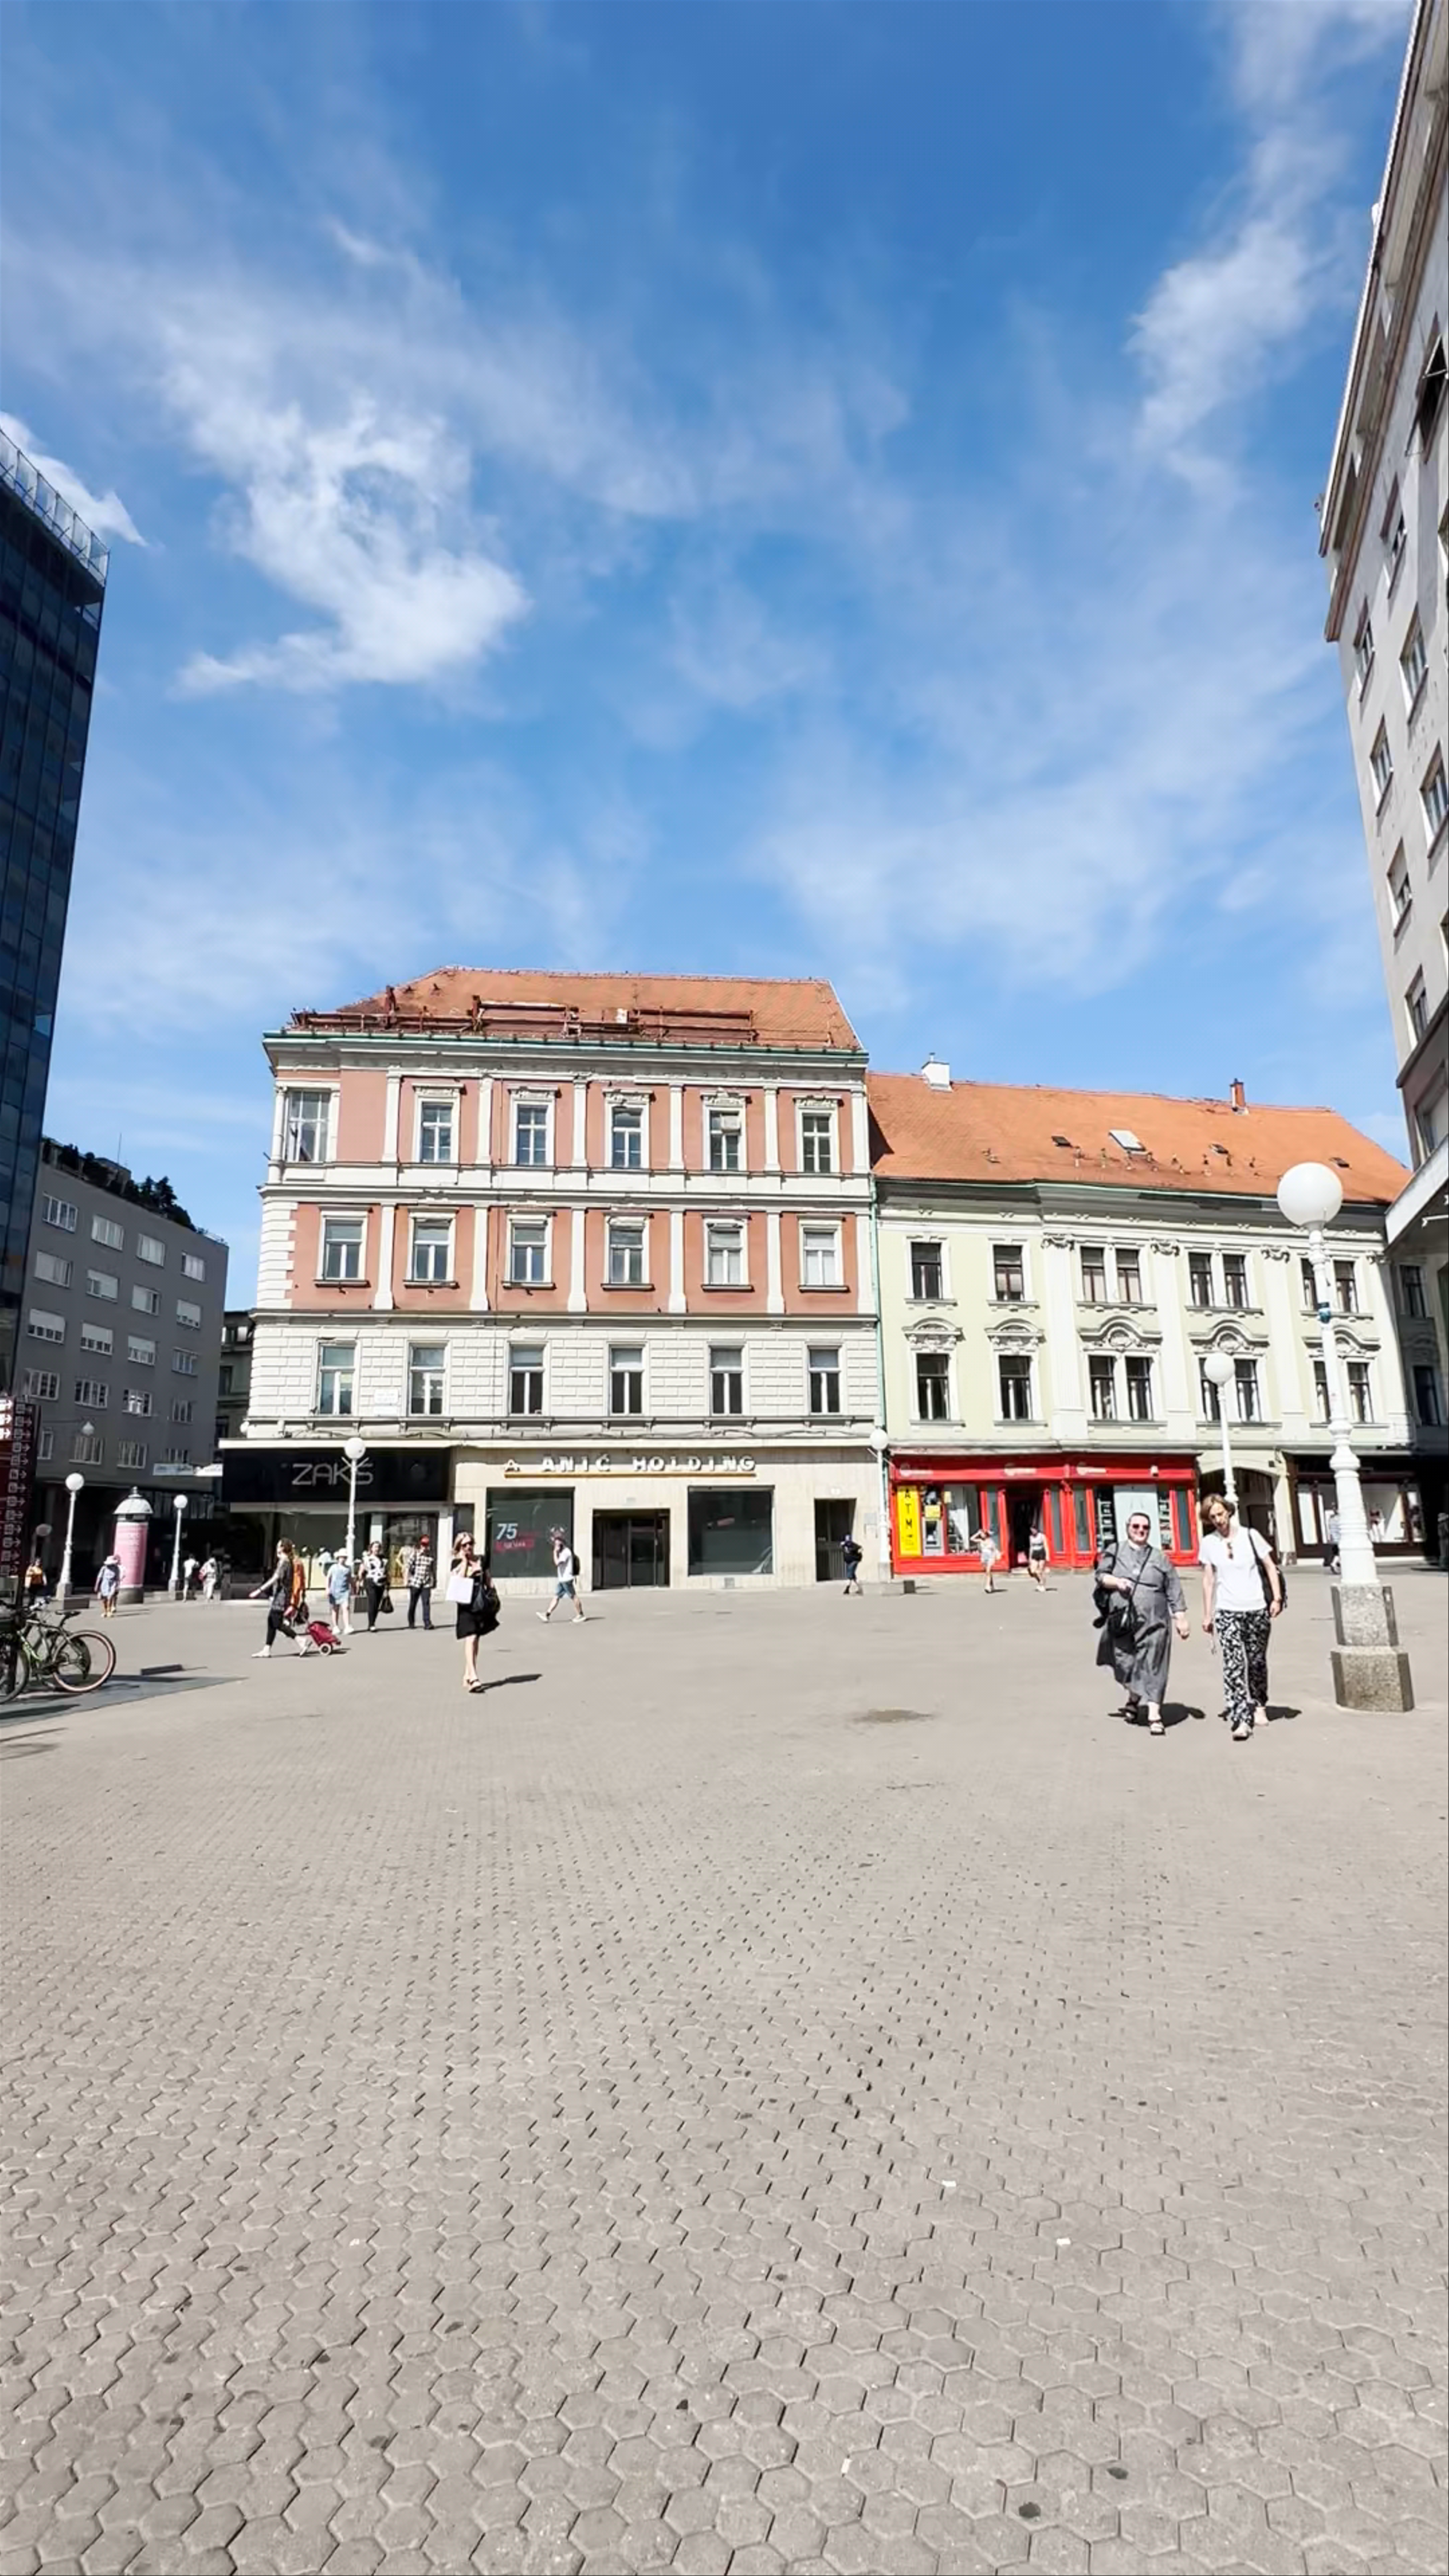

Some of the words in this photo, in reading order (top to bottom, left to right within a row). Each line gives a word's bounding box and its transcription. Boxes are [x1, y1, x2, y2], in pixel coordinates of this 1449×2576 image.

[542, 1454, 610, 1471] ANIĆ
[632, 1456, 755, 1471] HOLDING
[292, 1463, 374, 1486] ZAKS
[496, 1523, 518, 1540] 75
